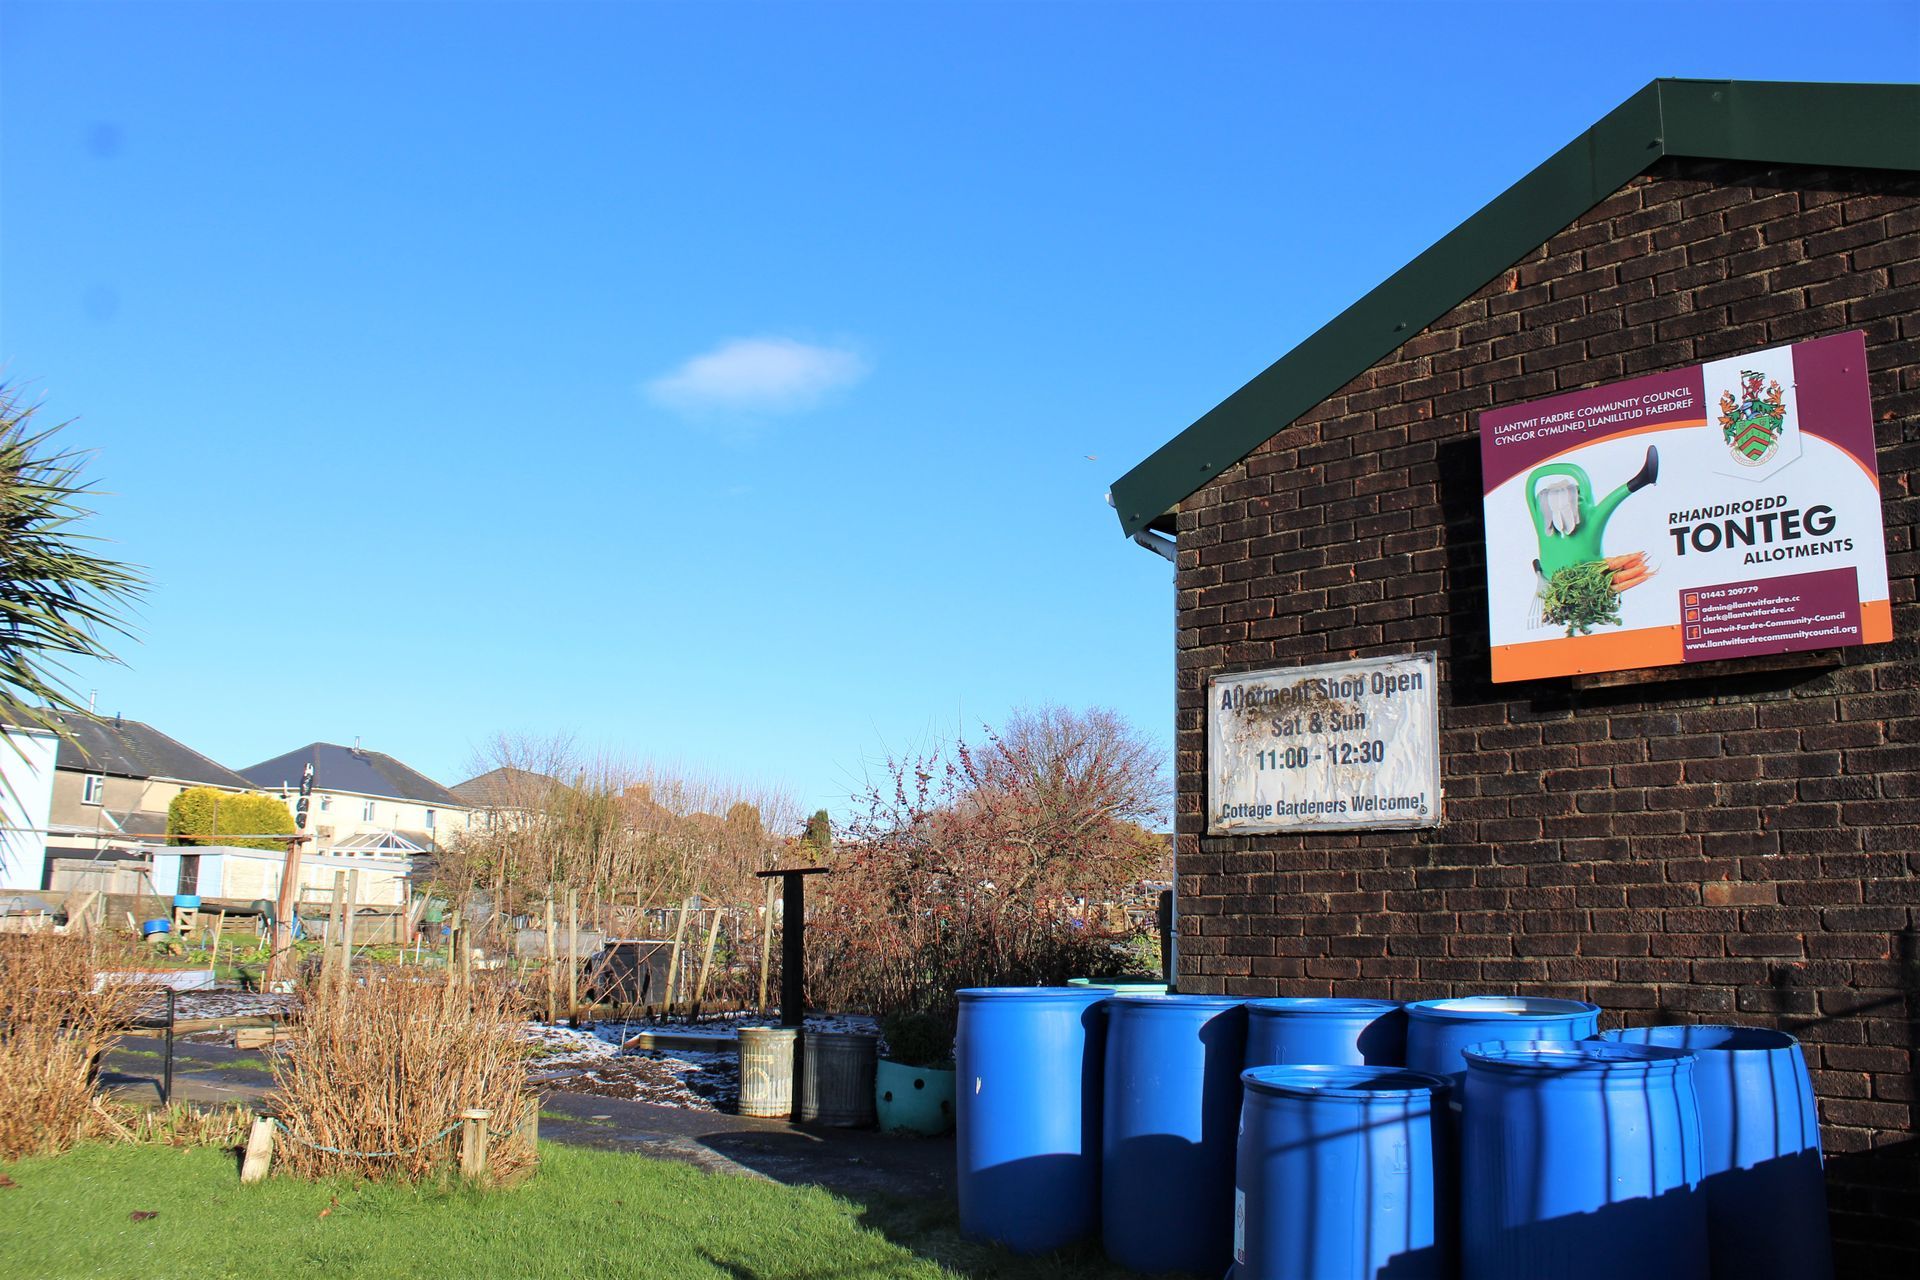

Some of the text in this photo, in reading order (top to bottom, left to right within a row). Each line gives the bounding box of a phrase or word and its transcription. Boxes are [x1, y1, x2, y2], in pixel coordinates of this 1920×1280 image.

[1494, 387, 1691, 435] LLANTWIT FARDRE COMMUNITY COUNCIL
[1495, 398, 1694, 446] CYNGOR CYMUNED LLANILLTUD FAERDREF
[1668, 495, 1787, 524] RHANDIROEDD
[1670, 505, 1836, 556] TONTEG
[1743, 538, 1854, 565] ALLOTMENTS
[1701, 586, 1759, 600] 01443 209779
[1702, 595, 1800, 613] admin@llantwitfardre.cc
[1686, 625, 1857, 650] www.llantwitfardrecommunitycouncil.org
[1703, 612, 1845, 635] Llantwit-Fardre-Community-Council
[1316, 677, 1365, 701] Shop
[1371, 671, 1423, 698] Open
[1271, 710, 1366, 737] Sat & Sun
[1256, 746, 1308, 770] 11:00
[1328, 740, 1384, 765] 12:30
[1222, 792, 1426, 820] Cottage Gardeners Welcome!
